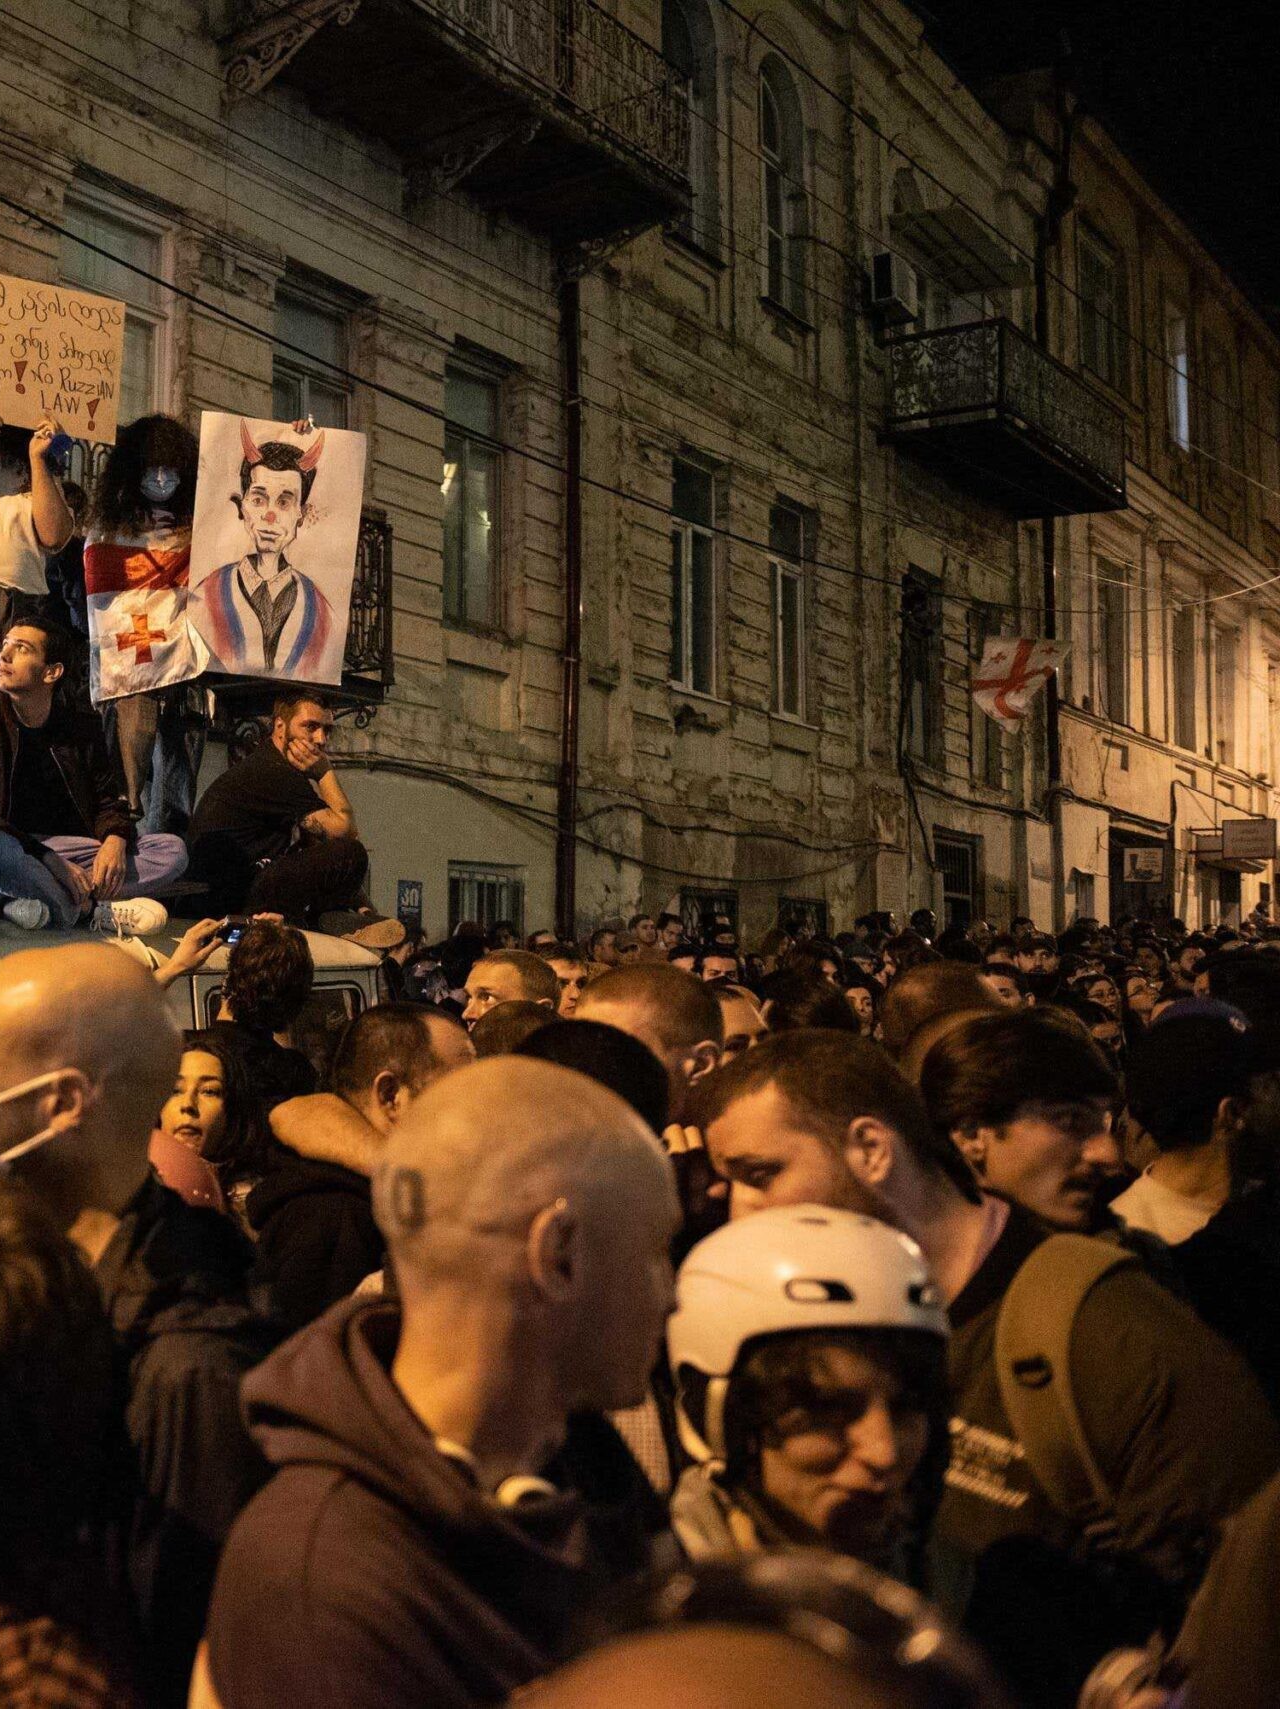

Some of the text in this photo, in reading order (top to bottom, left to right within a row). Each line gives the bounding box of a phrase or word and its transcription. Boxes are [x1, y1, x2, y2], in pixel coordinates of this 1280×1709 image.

[8, 290, 66, 322] კაცის
[69, 300, 121, 338] დედა
[10, 326, 49, 360] ვინც
